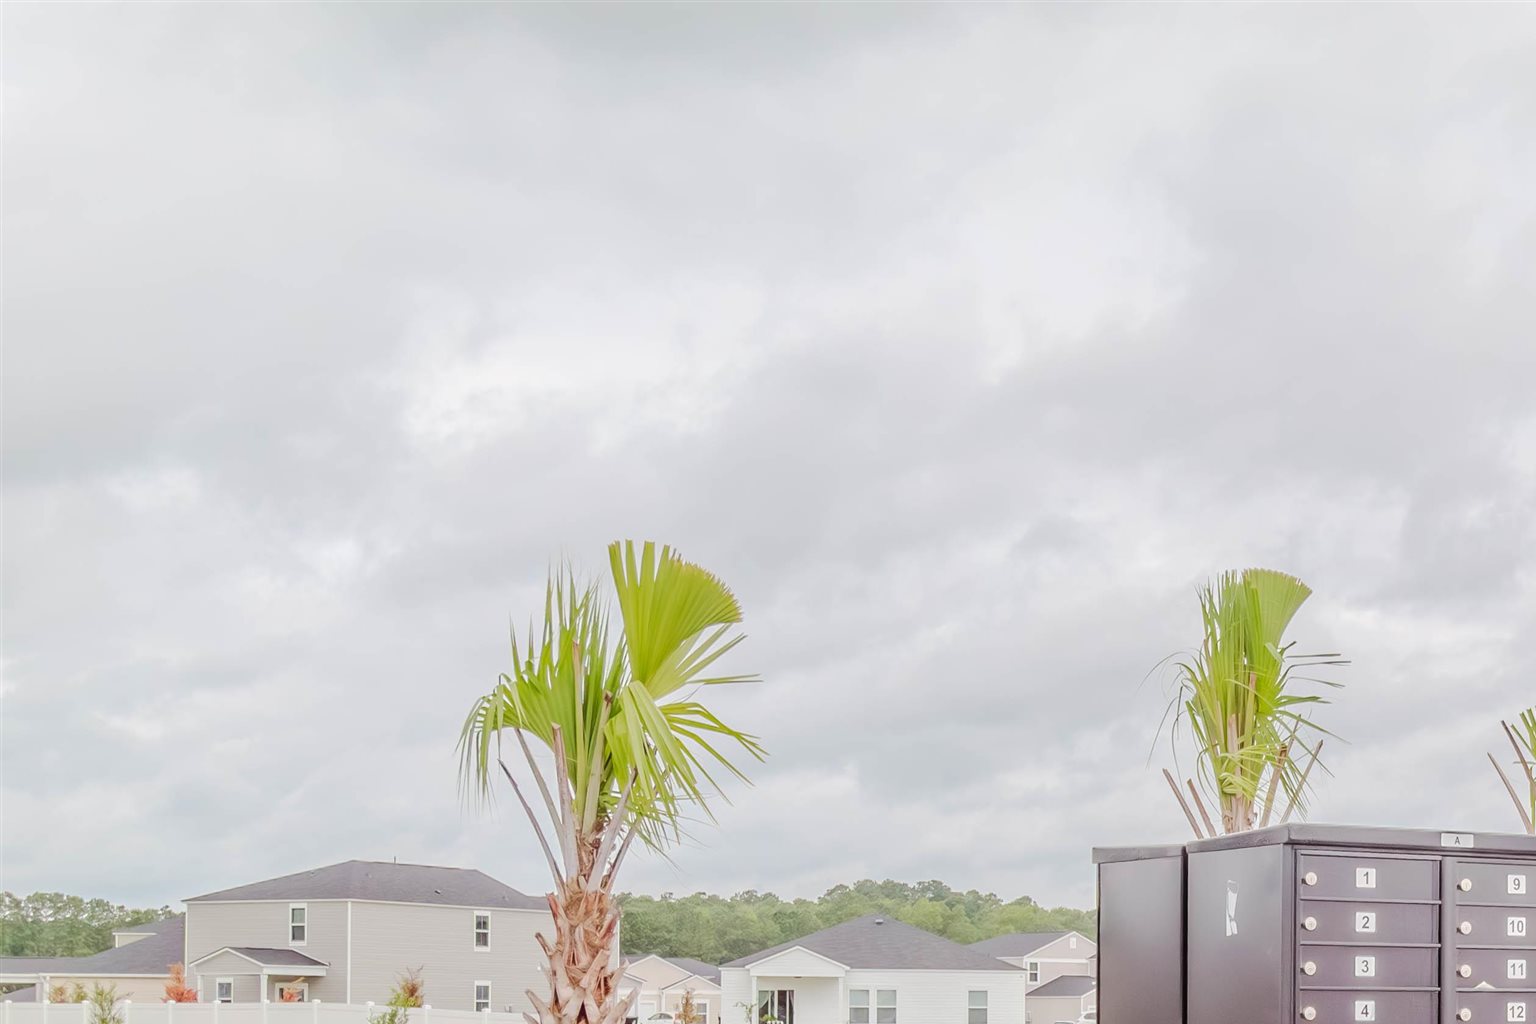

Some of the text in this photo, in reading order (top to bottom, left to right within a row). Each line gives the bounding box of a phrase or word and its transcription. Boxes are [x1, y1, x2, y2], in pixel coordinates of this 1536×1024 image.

[1454, 835, 1461, 846] A
[1363, 871, 1369, 885] 1
[1512, 877, 1521, 891] 9
[1361, 915, 1370, 929] 2
[1509, 919, 1524, 934] 10
[1361, 959, 1370, 974] 3
[1510, 962, 1524, 977] 11
[1360, 1004, 1370, 1018] 4
[1509, 1005, 1524, 1019] 12
